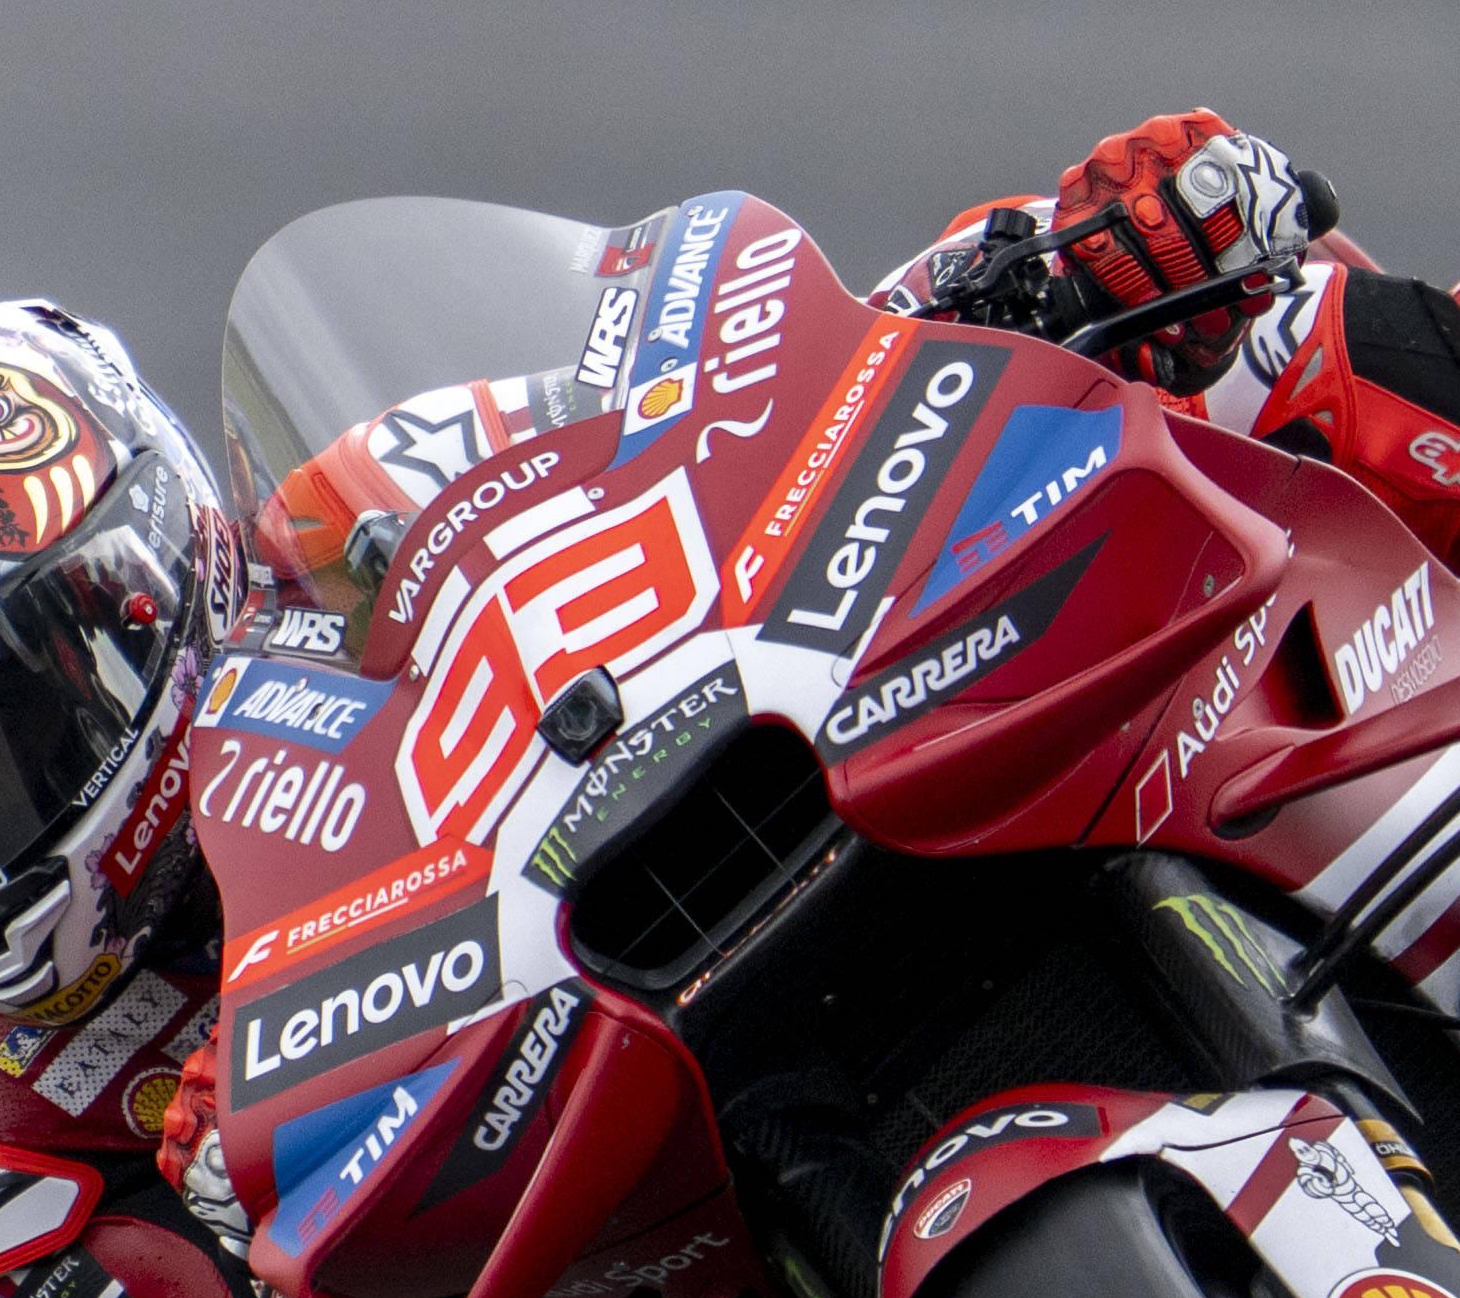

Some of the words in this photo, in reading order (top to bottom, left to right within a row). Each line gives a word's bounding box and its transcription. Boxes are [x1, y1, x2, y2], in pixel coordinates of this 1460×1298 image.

[577, 287, 638, 389] WRS
[660, 207, 727, 349] ADVANCE
[704, 228, 802, 394] riello
[765, 330, 899, 537] FRECCIAROSSA
[787, 361, 974, 631] Lenovo
[1011, 446, 1108, 525] TIM
[210, 506, 232, 633] SHOE
[388, 451, 561, 624] VARGROUP
[272, 608, 345, 653] WRS
[400, 471, 716, 846] 93
[825, 614, 1020, 744] CARRERA
[1334, 561, 1434, 715] DUCATI
[72, 727, 139, 808] VERTICAL
[233, 680, 366, 739] ADVANCE
[563, 677, 738, 832] MONSTER
[597, 718, 711, 822] ENERGY
[1176, 655, 1240, 780] Audi
[222, 750, 366, 852] riello
[287, 851, 468, 948] FRECCIAROSSA
[55, 989, 162, 1099] EATALY
[245, 940, 485, 1081] Lenovo
[473, 987, 580, 1151] CARRERA
[340, 1086, 419, 1185] TIM
